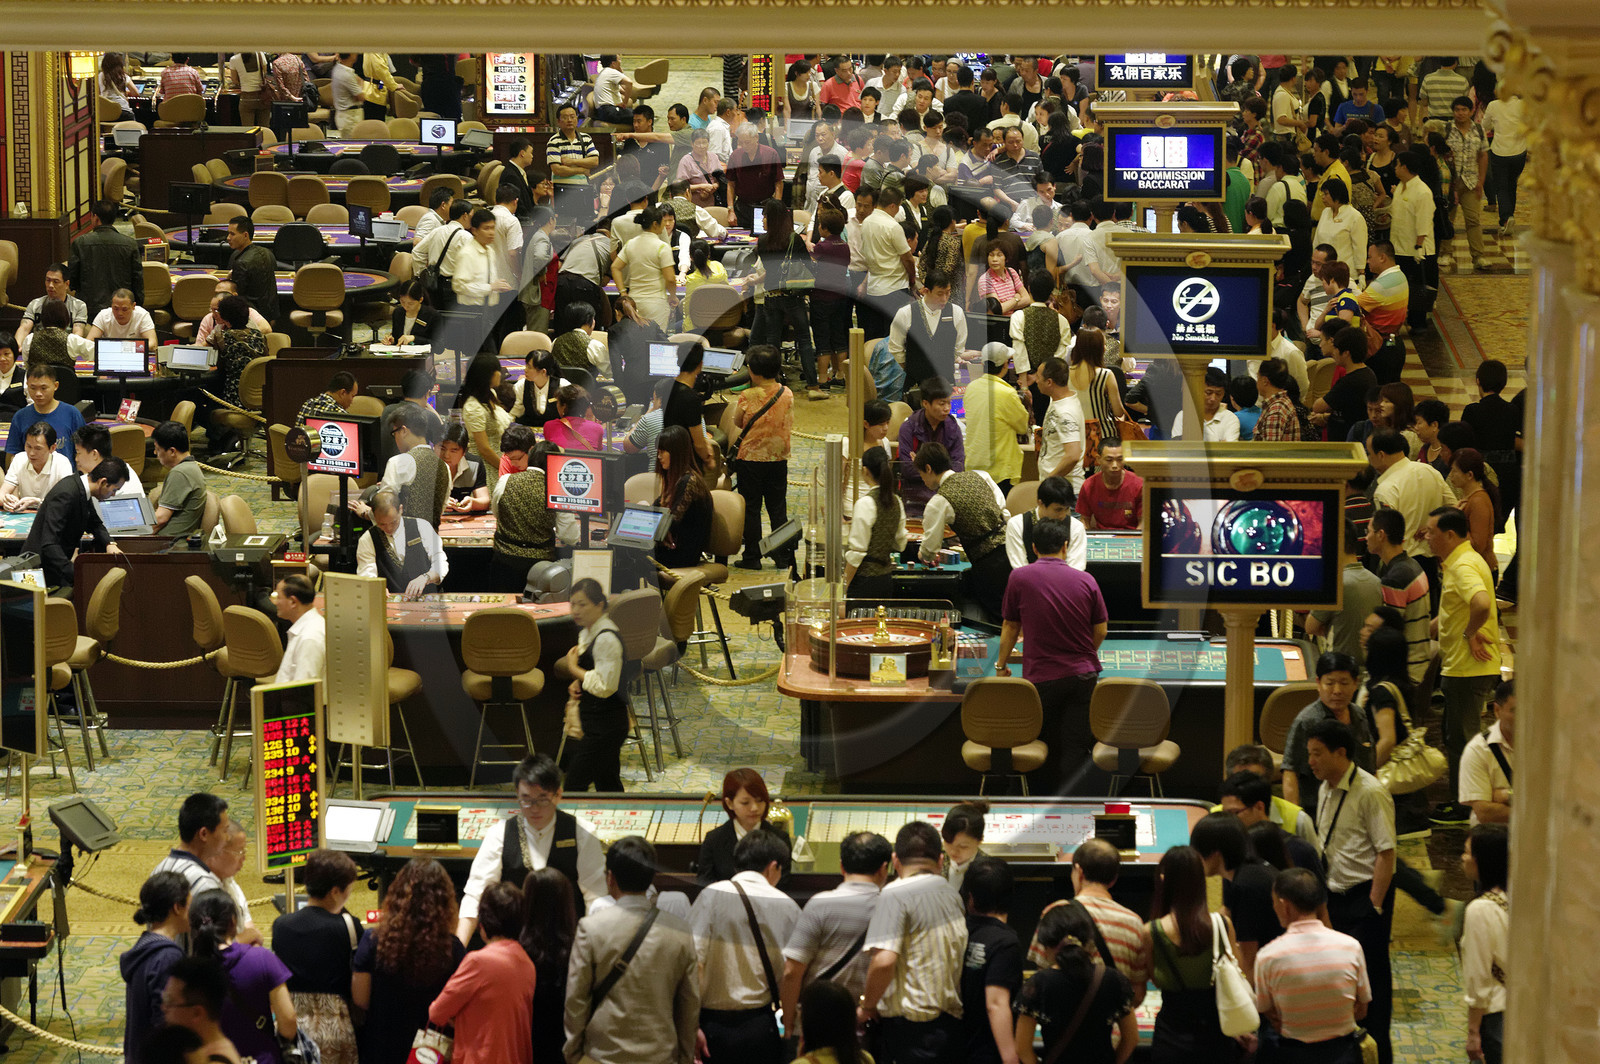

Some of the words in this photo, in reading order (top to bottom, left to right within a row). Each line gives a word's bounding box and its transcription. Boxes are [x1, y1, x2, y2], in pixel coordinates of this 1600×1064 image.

[1110, 65, 1182, 80] 免佣百家乐
[1123, 170, 1138, 180] NO
[1140, 170, 1205, 180] COMMISSION
[1138, 180, 1190, 189] BACCARAT
[1171, 333, 1184, 341] No
[1185, 333, 1219, 343] Smoking
[1186, 561, 1238, 587] SIC
[1250, 561, 1295, 587] BO
[285, 718, 298, 729] 12
[264, 739, 283, 751] 126
[285, 738, 294, 748] 9
[264, 749, 284, 760] 235
[286, 746, 300, 757] 10
[264, 767, 284, 779] 234
[286, 766, 295, 776] 9
[287, 793, 301, 804] 10
[266, 805, 284, 817] 136
[287, 802, 301, 813] 10
[266, 815, 284, 826] 221
[287, 813, 296, 822] 5
[289, 840, 302, 850] 12
